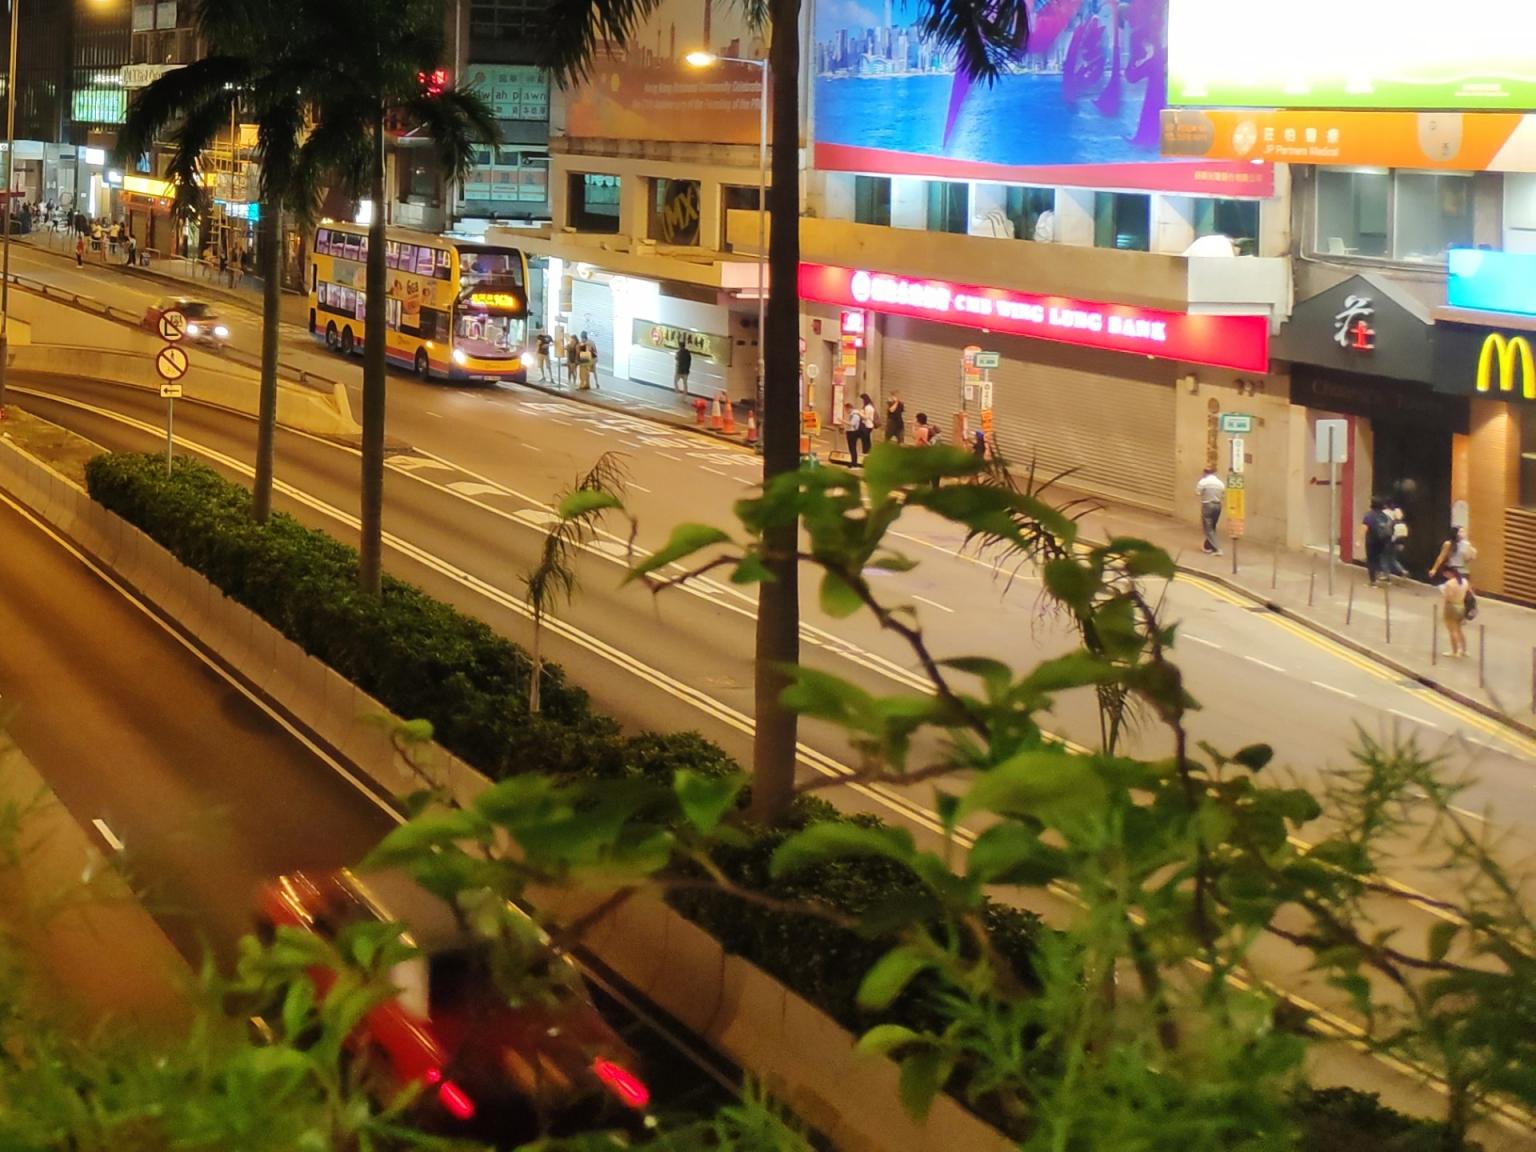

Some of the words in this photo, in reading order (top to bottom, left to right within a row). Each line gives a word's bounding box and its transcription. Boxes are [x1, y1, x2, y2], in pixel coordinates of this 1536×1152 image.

[996, 299, 1044, 323] WING
[1048, 307, 1103, 333] LUNG
[1107, 316, 1167, 341] BANK
